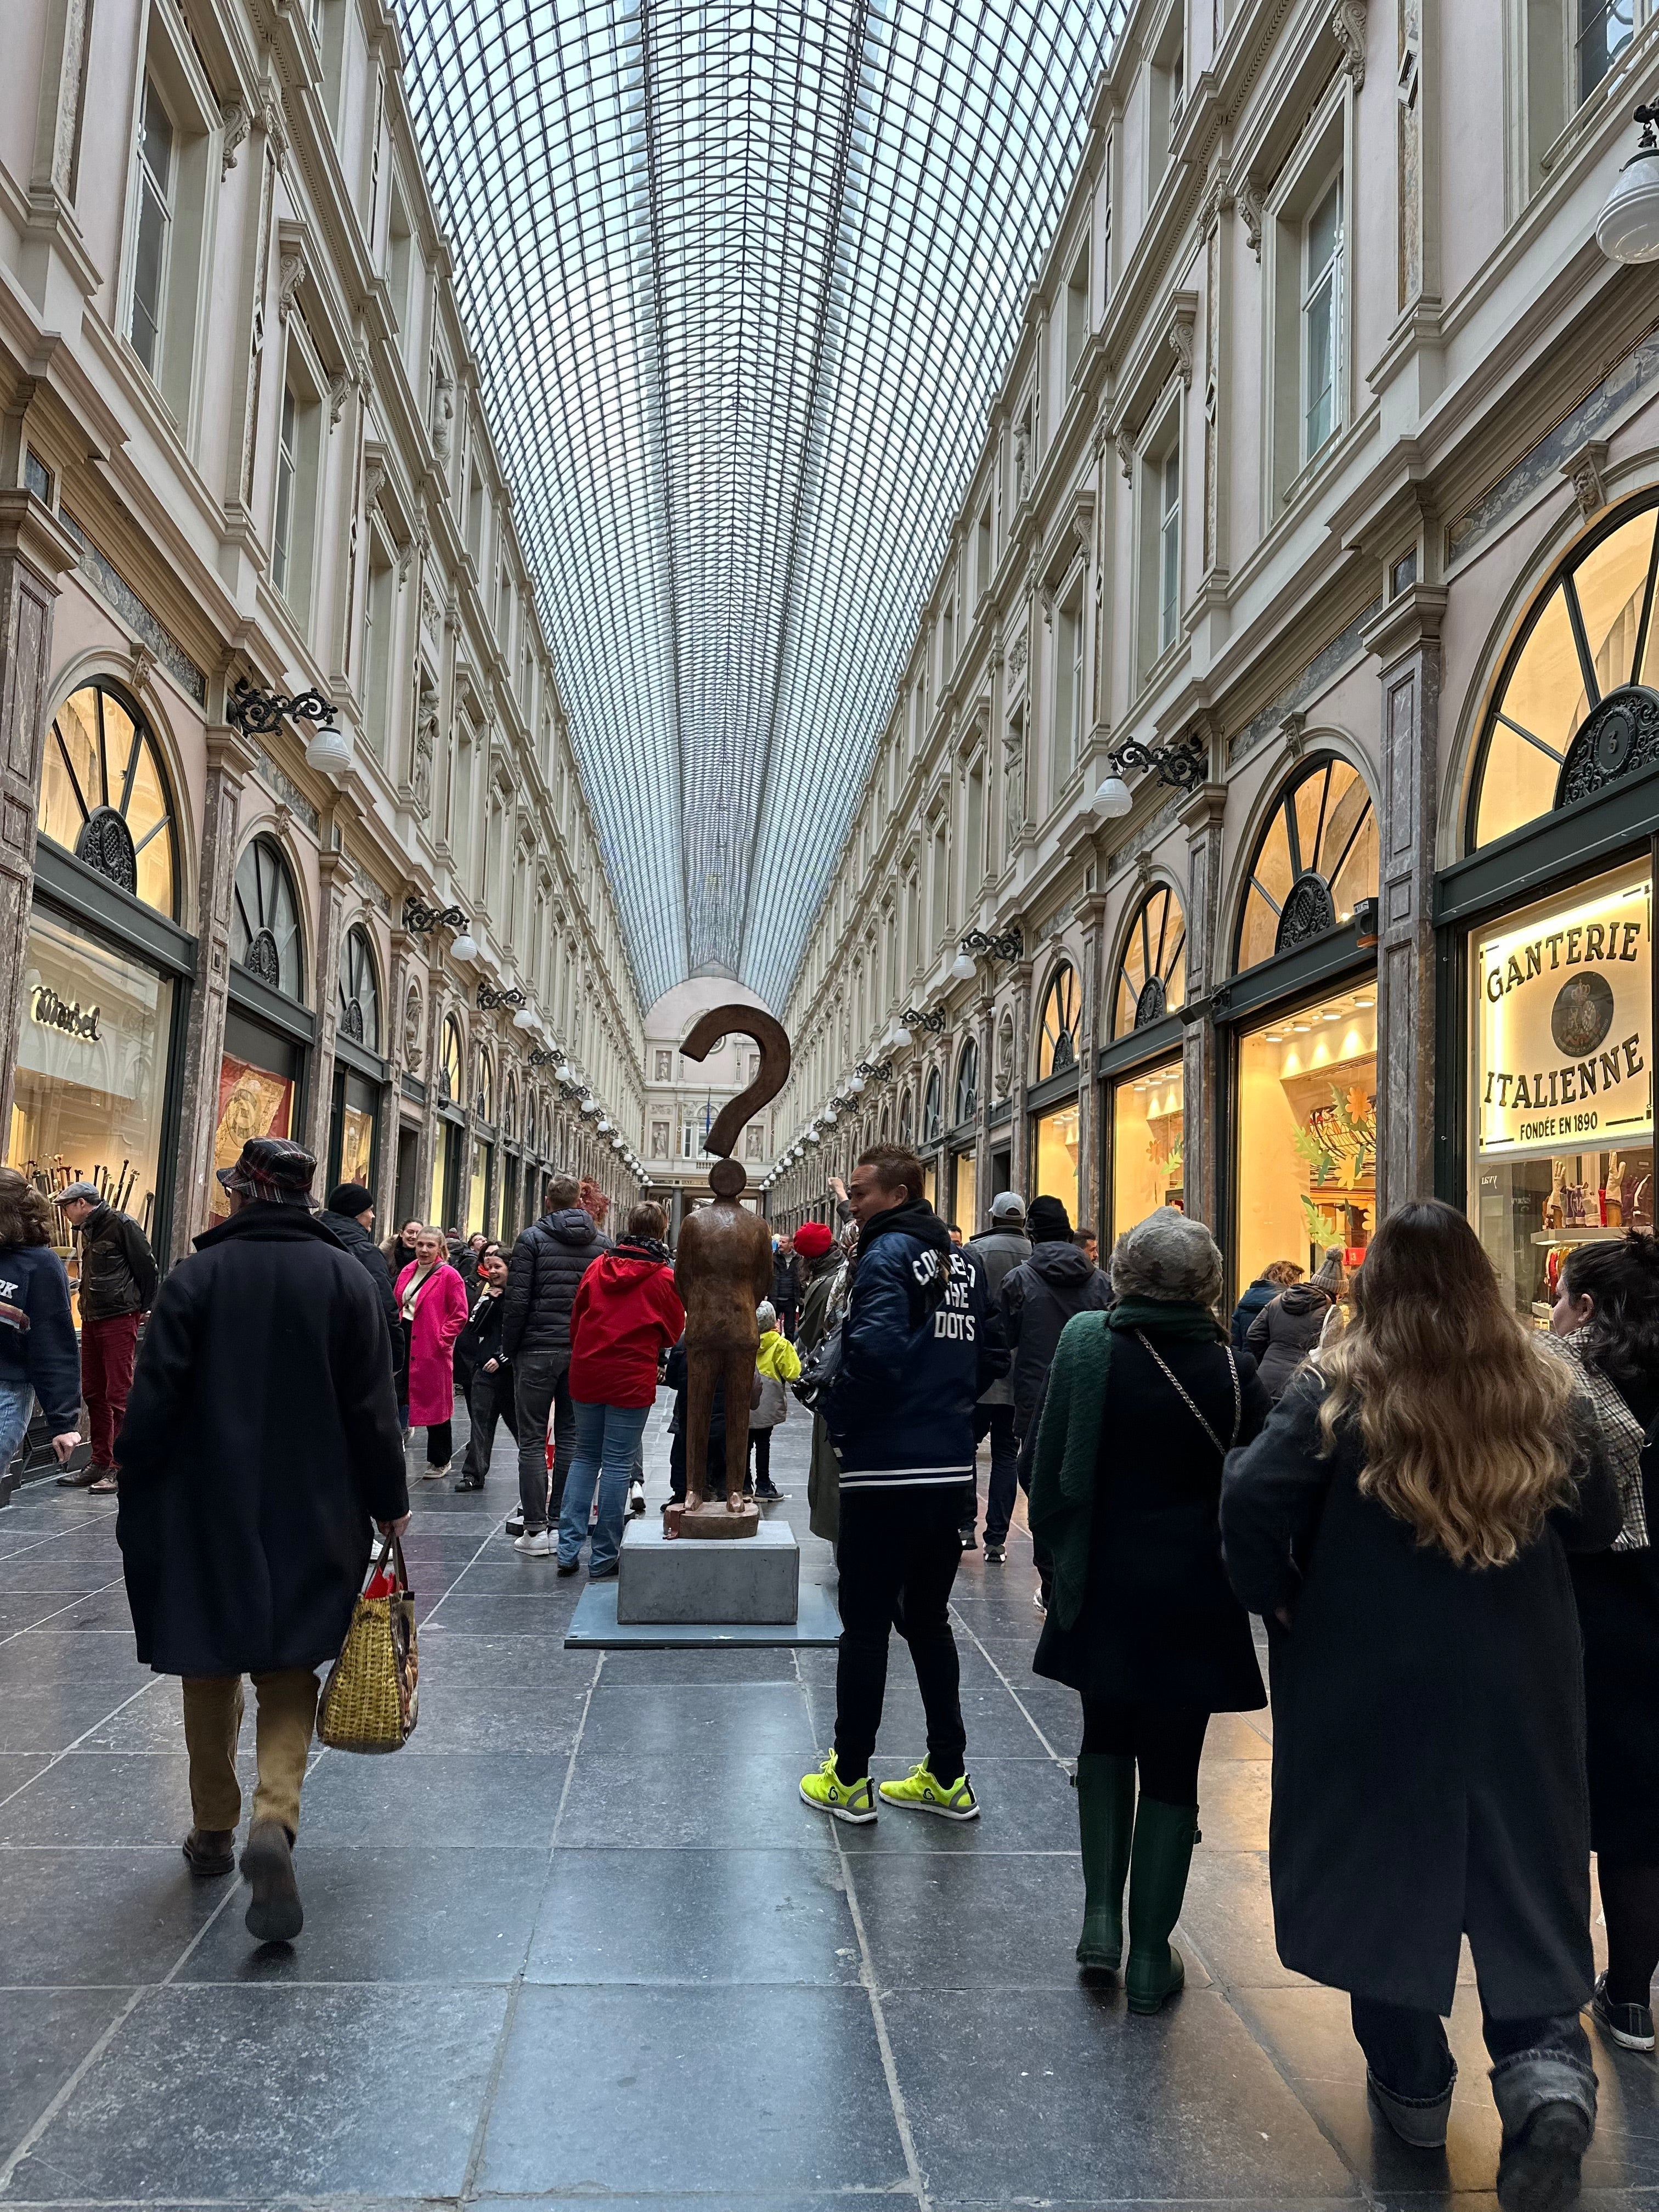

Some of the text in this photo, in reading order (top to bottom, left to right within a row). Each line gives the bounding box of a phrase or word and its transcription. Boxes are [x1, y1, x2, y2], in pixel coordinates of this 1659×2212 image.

[1608, 730, 1618, 754] 3
[1487, 922, 1640, 1002] GANTERIE
[1484, 1032, 1644, 1108] ITALIENNE
[1520, 1111, 1598, 1141] FONDÉE EN 1890
[934, 1311, 975, 1341] DOTS
